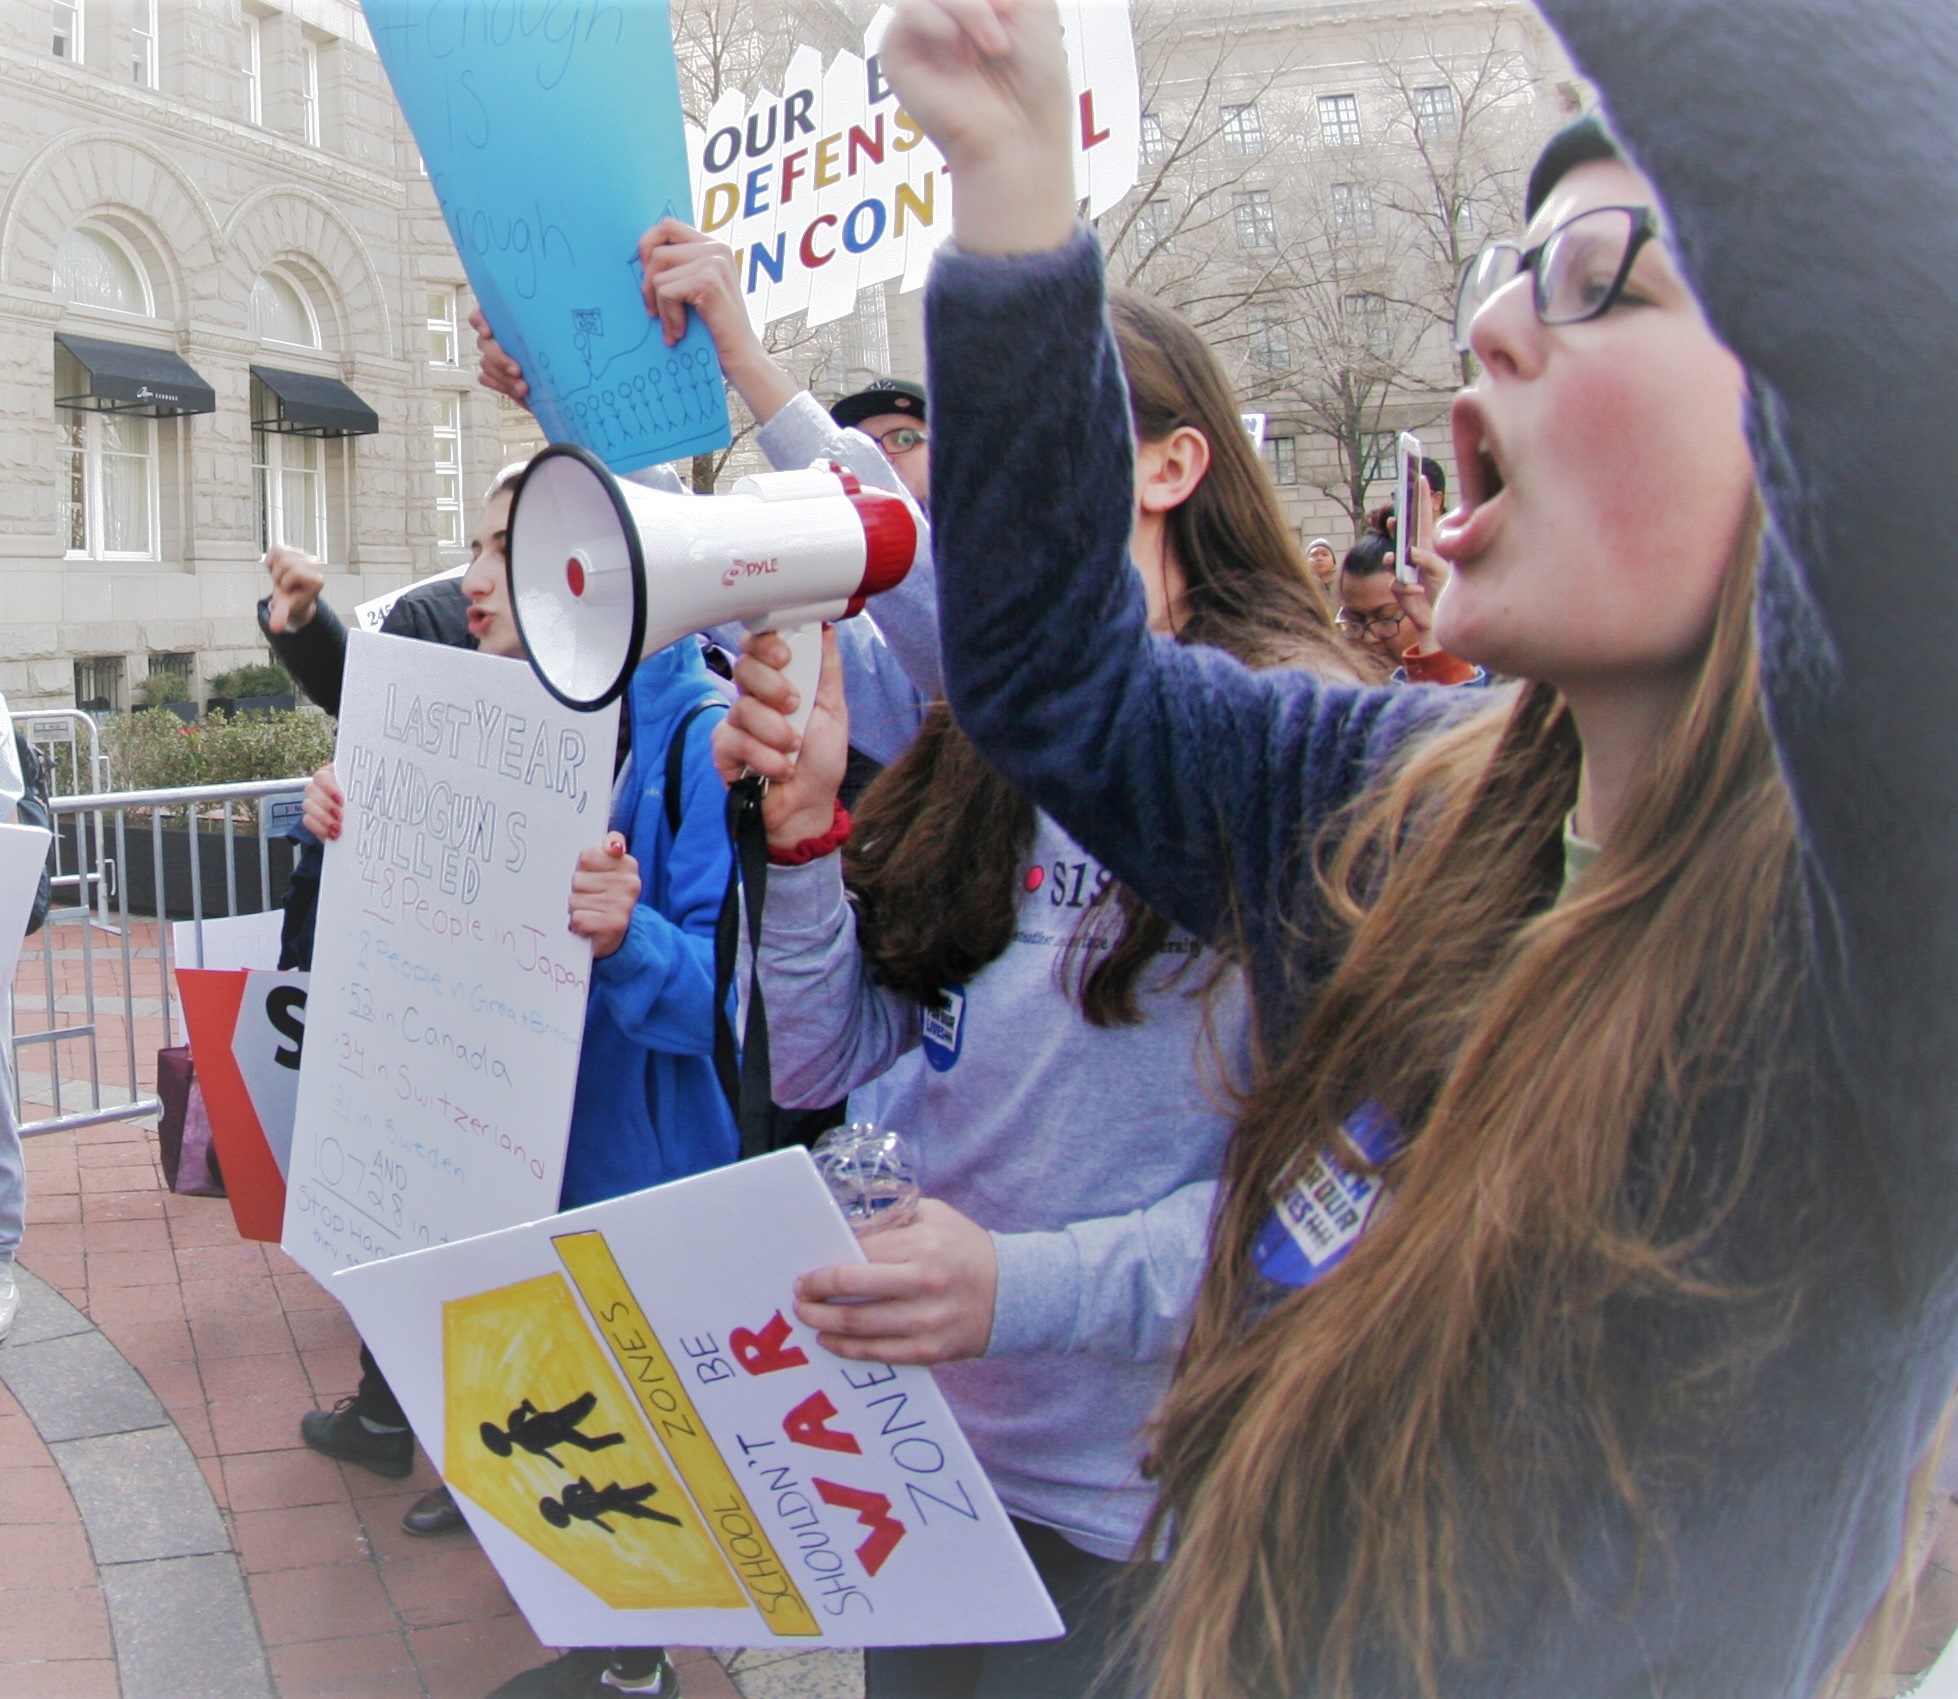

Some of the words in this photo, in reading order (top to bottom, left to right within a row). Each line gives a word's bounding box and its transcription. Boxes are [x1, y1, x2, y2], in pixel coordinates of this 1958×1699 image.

[700, 106, 925, 234] DEFENS
[703, 88, 816, 174] OUR
[383, 682, 472, 759] LAST
[474, 699, 589, 814] YEAR,
[356, 811, 482, 904] KILLED
[401, 1006, 514, 1088] Canada
[372, 1149, 407, 1190] AND
[385, 1118, 466, 1185] Sweden
[395, 1063, 545, 1180] Switzerland
[1312, 1178, 1360, 1232] OUR
[601, 1301, 697, 1439] ZONES
[680, 1332, 736, 1385] BE
[728, 1308, 907, 1577] WAR
[713, 1494, 805, 1614] SCHOOL
[735, 1433, 874, 1615] SHOULDN'T
